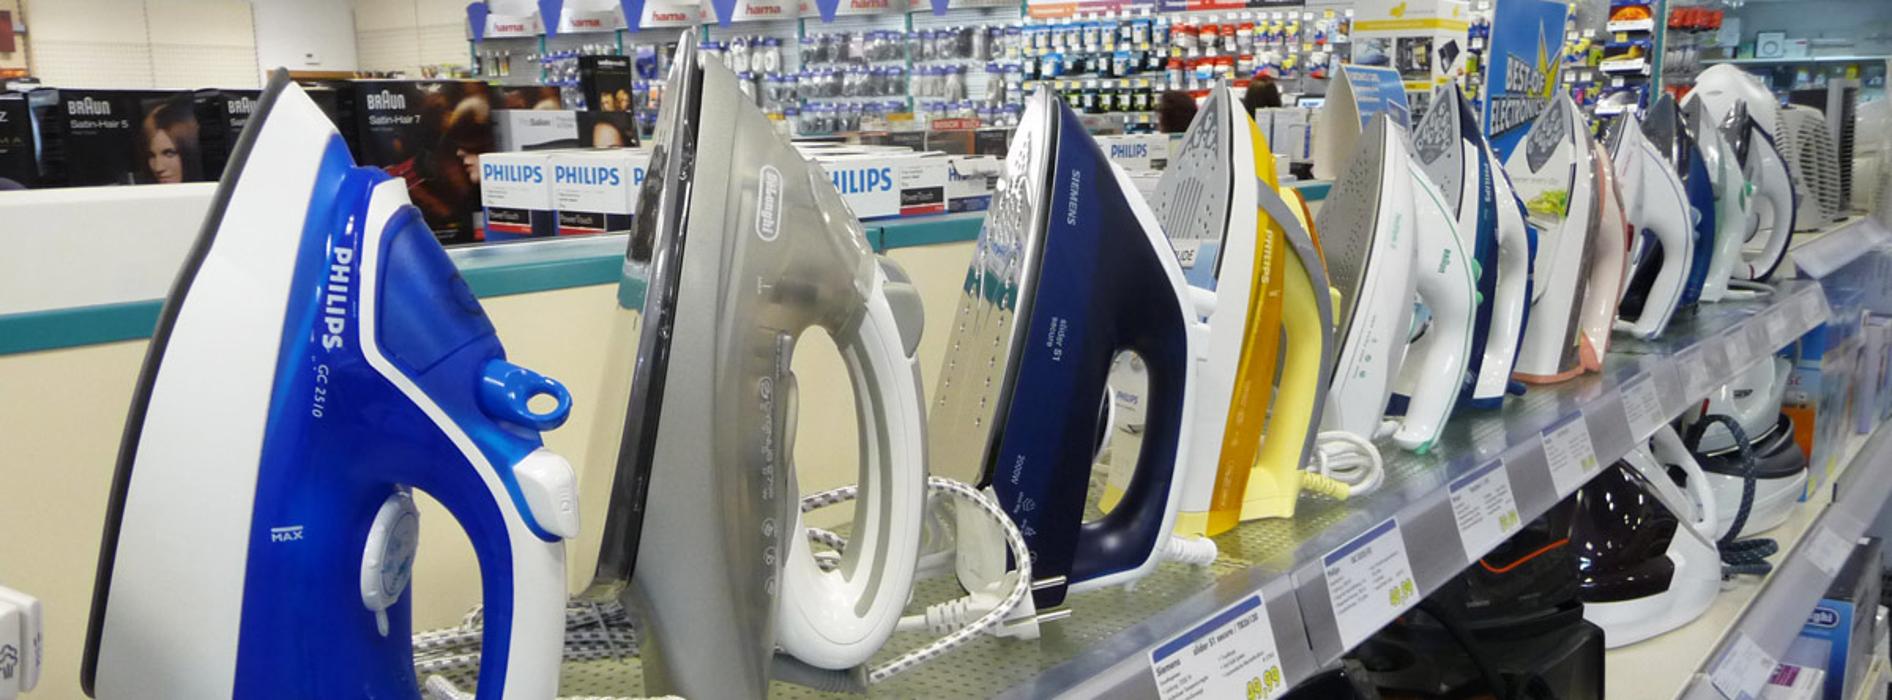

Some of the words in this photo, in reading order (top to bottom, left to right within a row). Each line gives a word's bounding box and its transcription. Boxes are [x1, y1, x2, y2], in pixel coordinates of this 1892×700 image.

[67, 96, 111, 115] BRAUN
[227, 96, 257, 114] BRAU
[367, 90, 406, 110] BRAUN
[70, 119, 120, 129] Satin-Hair
[121, 119, 129, 128] 5
[369, 115, 413, 126] Satin-Hair
[414, 114, 421, 124] 7
[1110, 143, 1148, 159] PHILIPS
[483, 163, 544, 184] PHILIPS
[555, 165, 621, 186] PHILIPS
[827, 167, 893, 194] HILIPS
[1066, 168, 1081, 227] SIEMENS
[322, 246, 353, 352] PHILIPS
[316, 363, 330, 385] GC
[311, 387, 327, 419] 2510
[271, 530, 304, 542] MAX
[1156, 658, 1181, 677] Siemens
